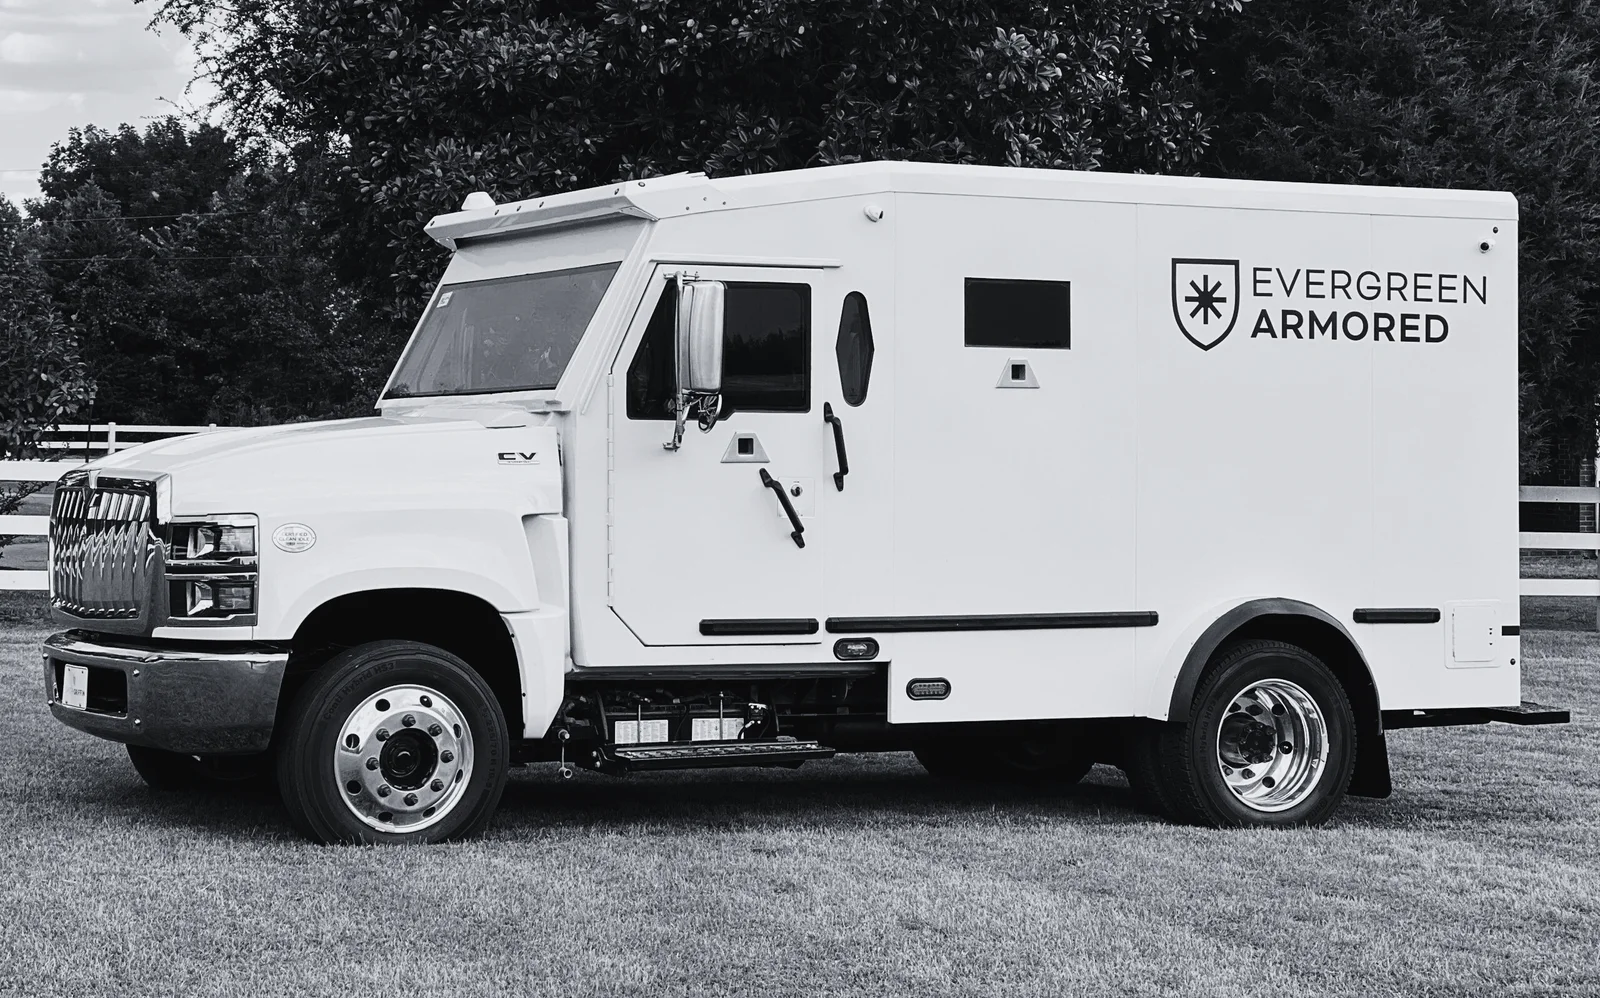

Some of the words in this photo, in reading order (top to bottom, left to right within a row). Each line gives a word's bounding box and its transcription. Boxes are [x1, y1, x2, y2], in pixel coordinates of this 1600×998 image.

[1253, 267, 1487, 305] EVERGREEN
[1250, 309, 1449, 343] ARMORED
[497, 452, 537, 460] CV
[342, 670, 372, 695] Hybrid
